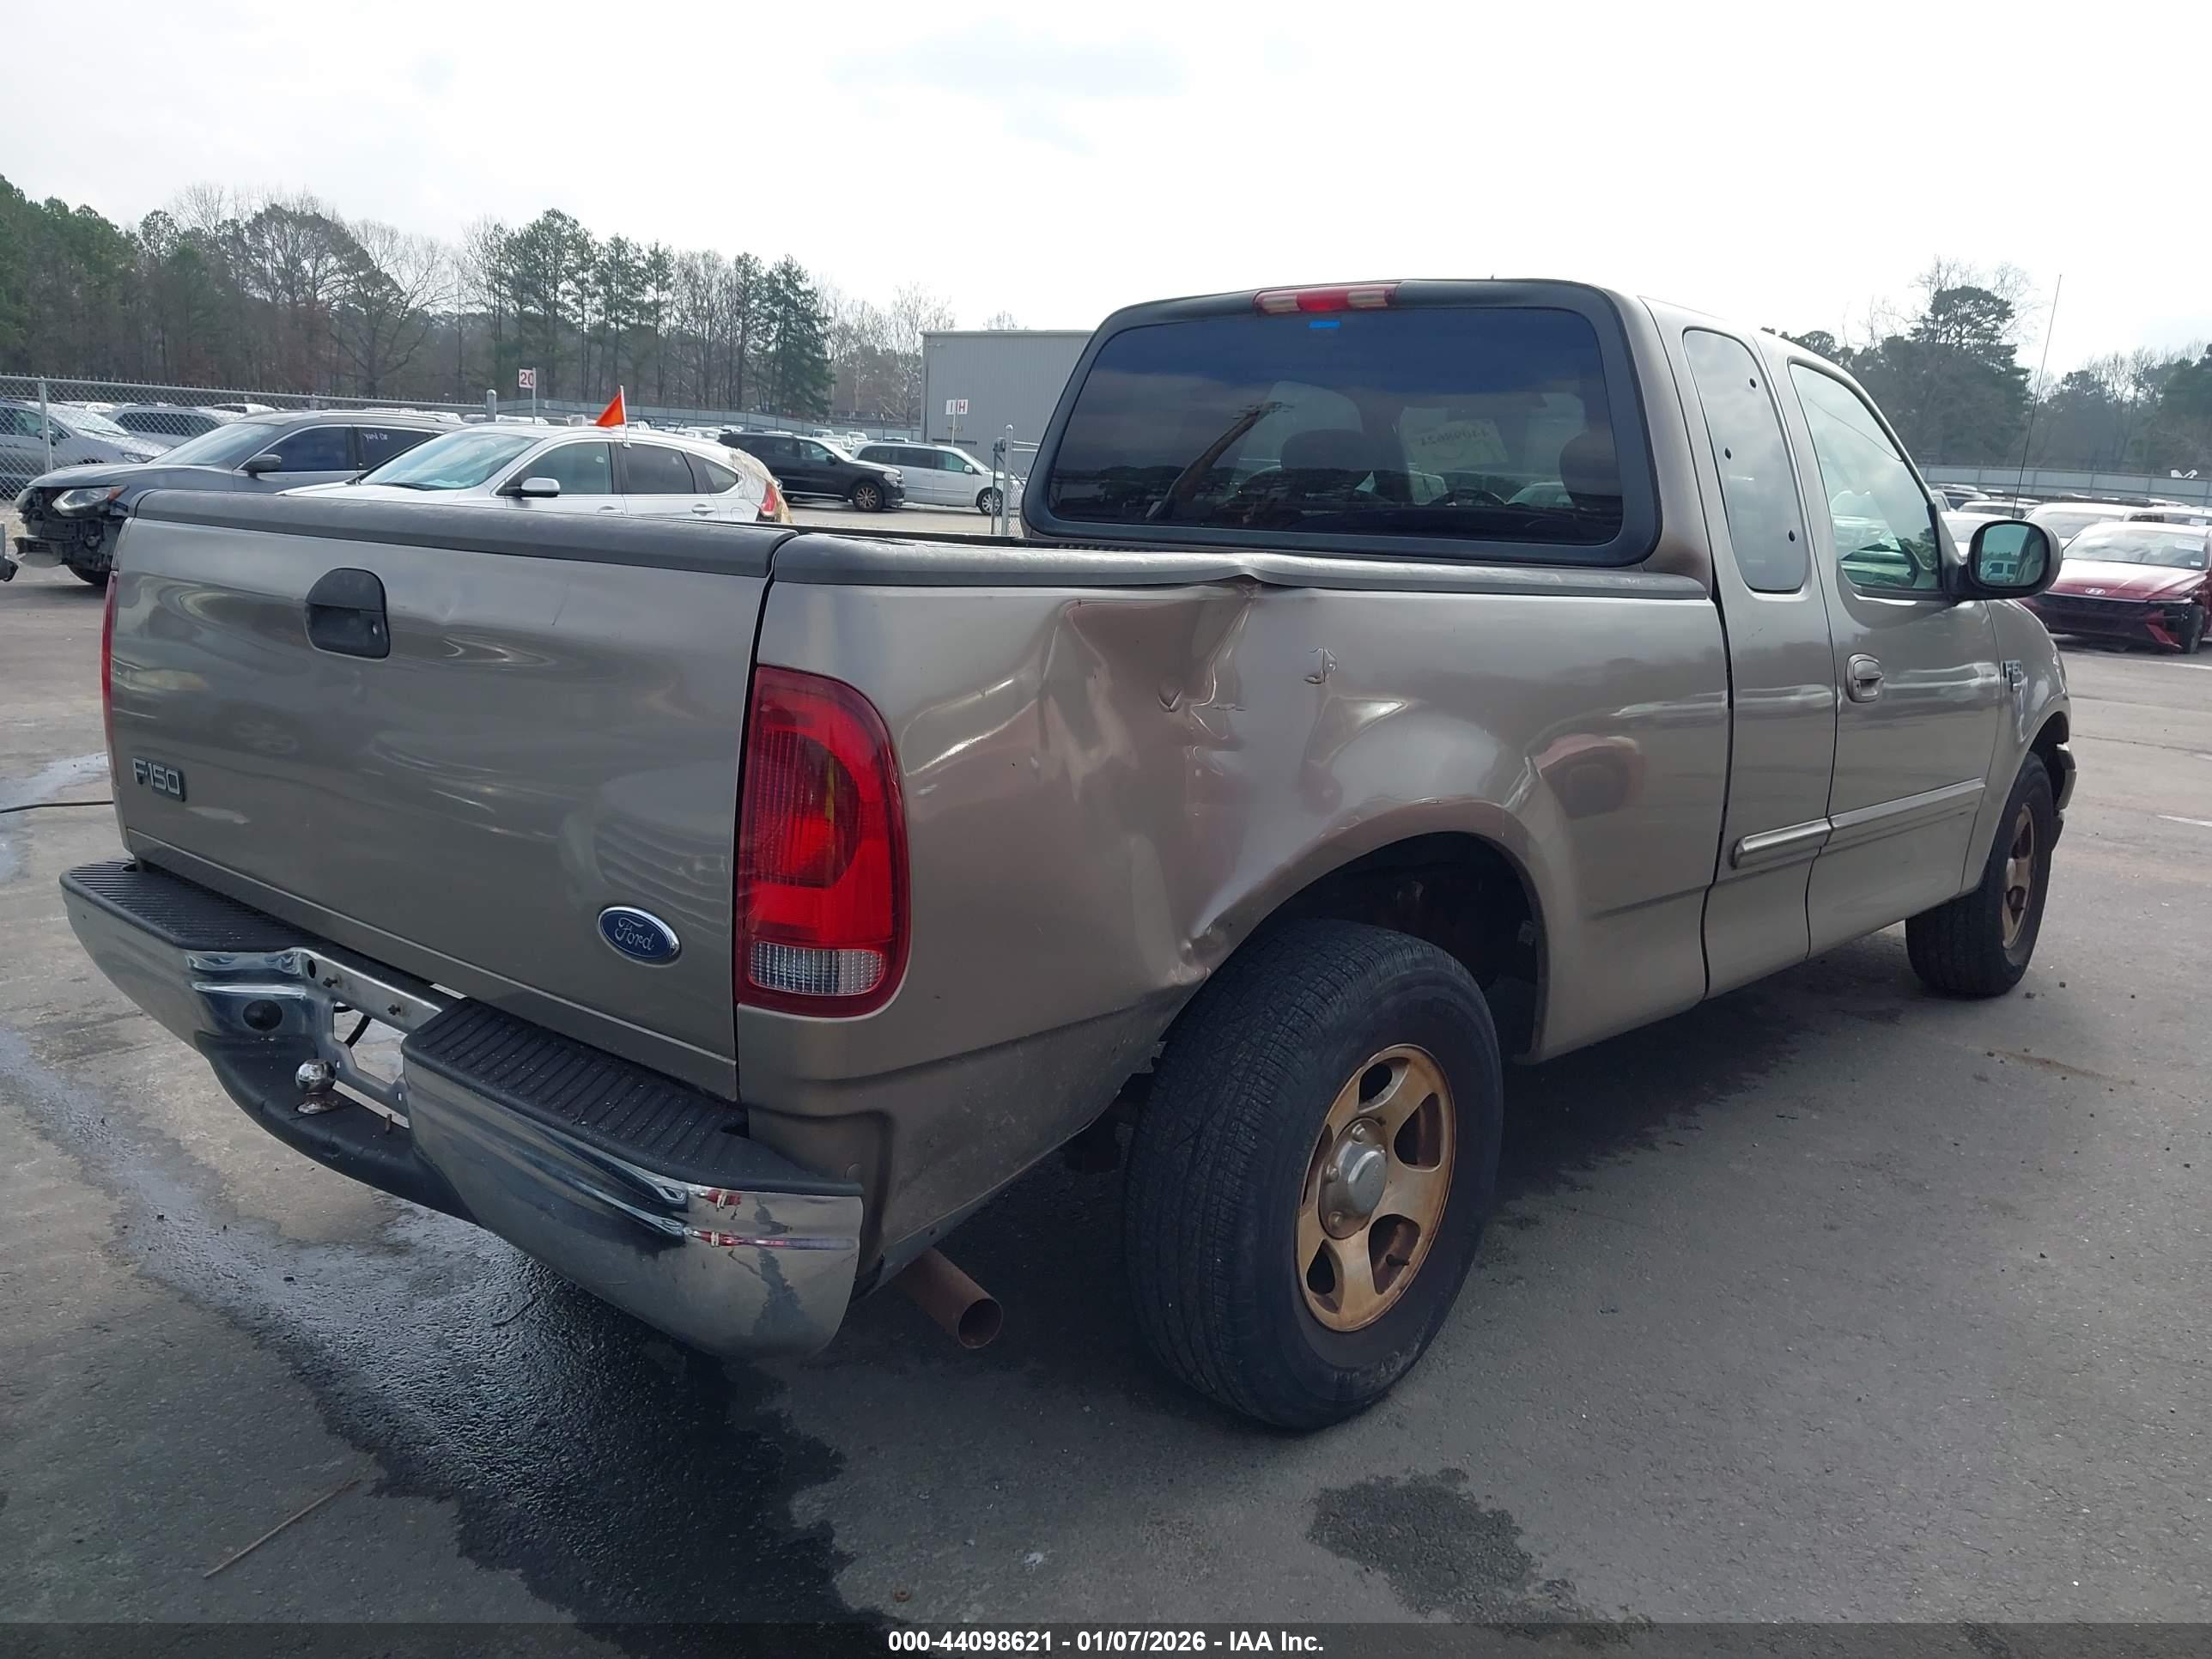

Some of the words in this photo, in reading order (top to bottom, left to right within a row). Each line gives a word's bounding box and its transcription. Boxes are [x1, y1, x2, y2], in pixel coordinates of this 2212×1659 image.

[520, 372, 534, 386] 20
[958, 400, 966, 413] H
[614, 917, 656, 951] Ford
